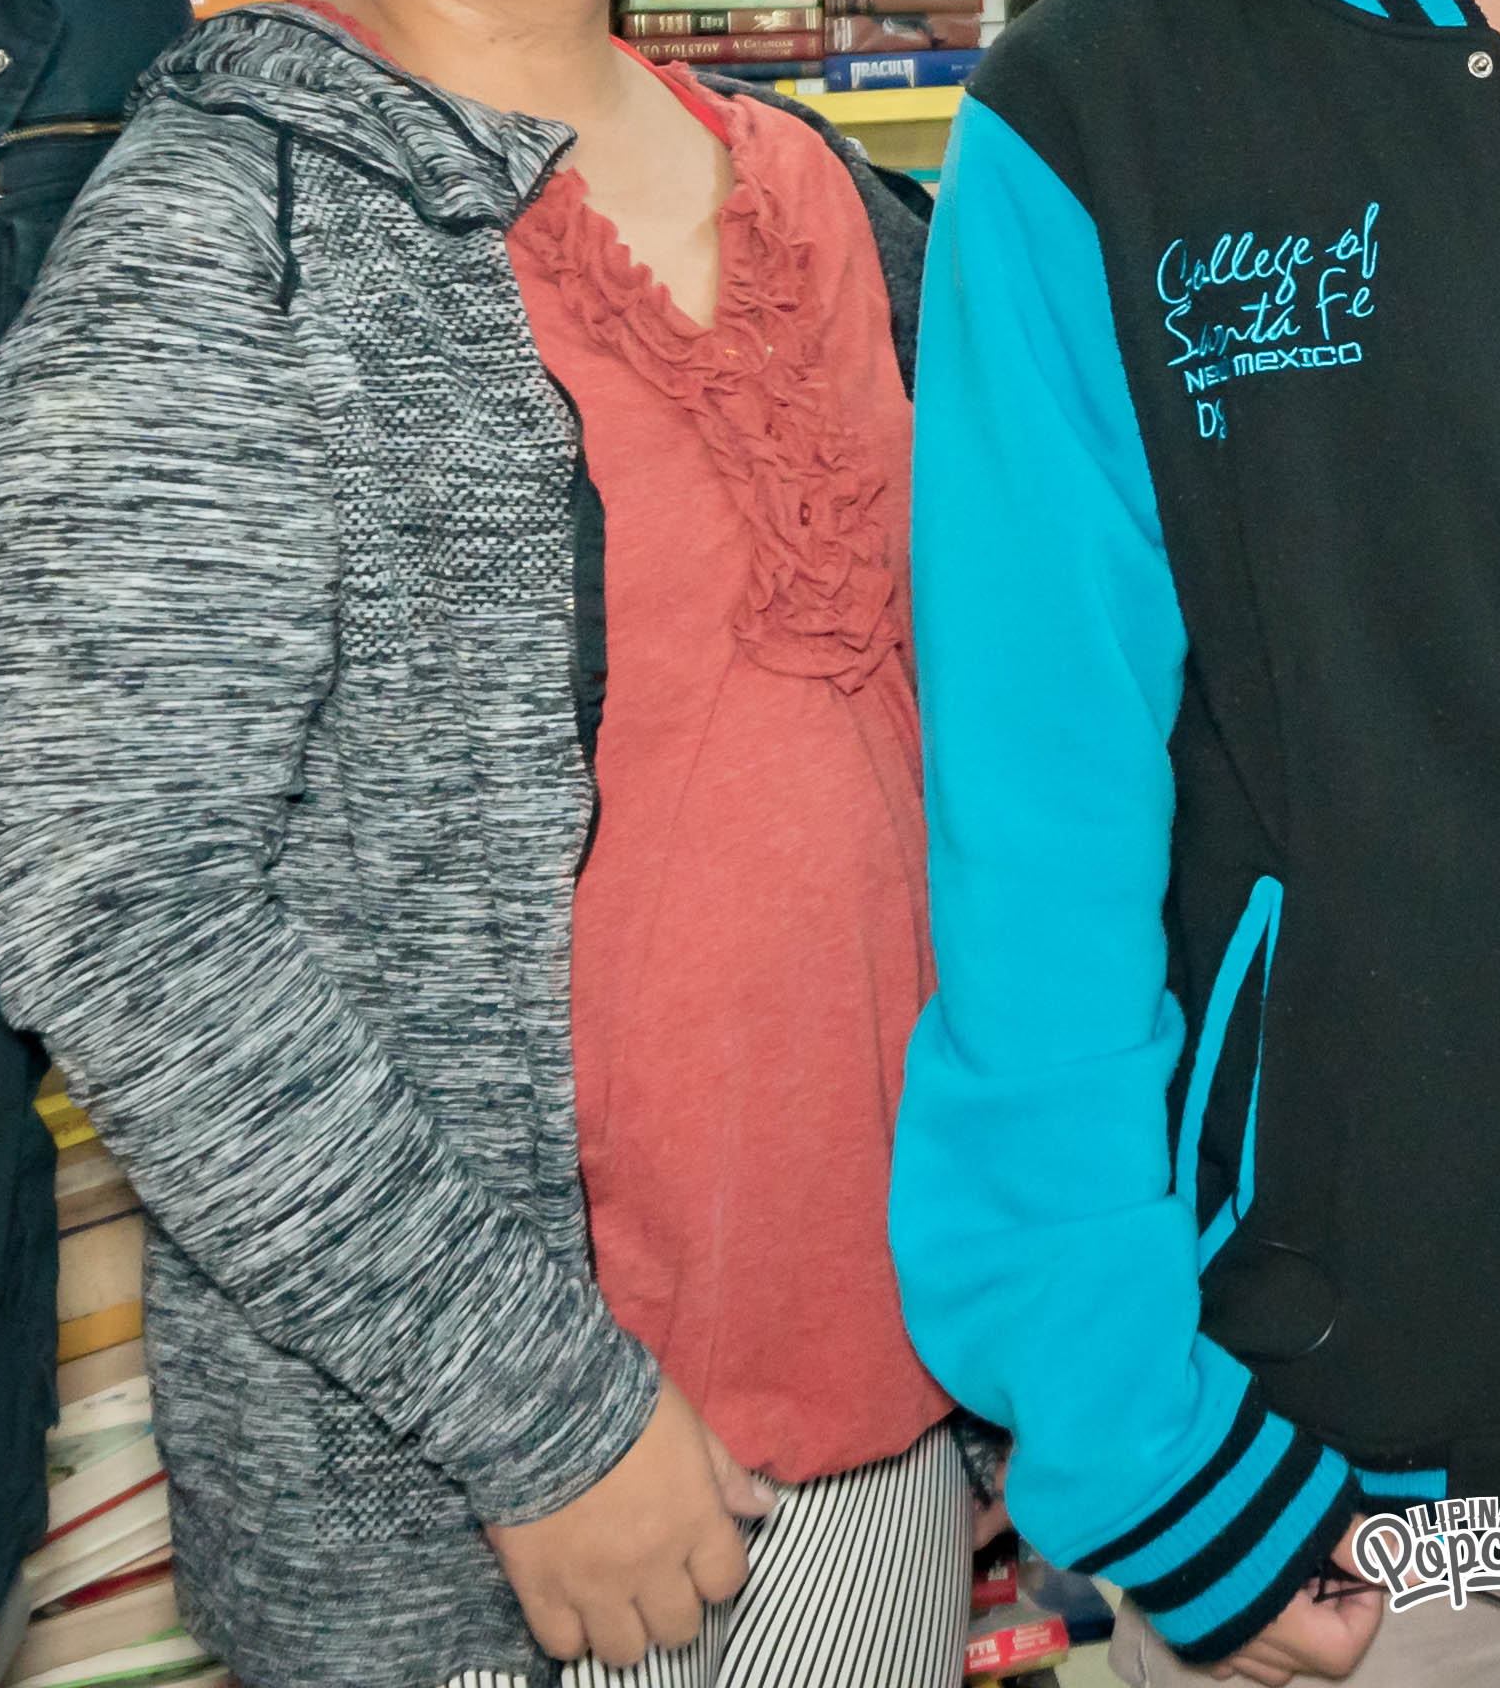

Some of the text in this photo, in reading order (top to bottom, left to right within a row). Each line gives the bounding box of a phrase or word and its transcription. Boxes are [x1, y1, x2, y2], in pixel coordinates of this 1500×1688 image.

[664, 42, 720, 57] TOLSTOY
[1156, 202, 1380, 306] College of
[1164, 266, 1375, 367] Santa Fe
[1184, 364, 1230, 394] NE
